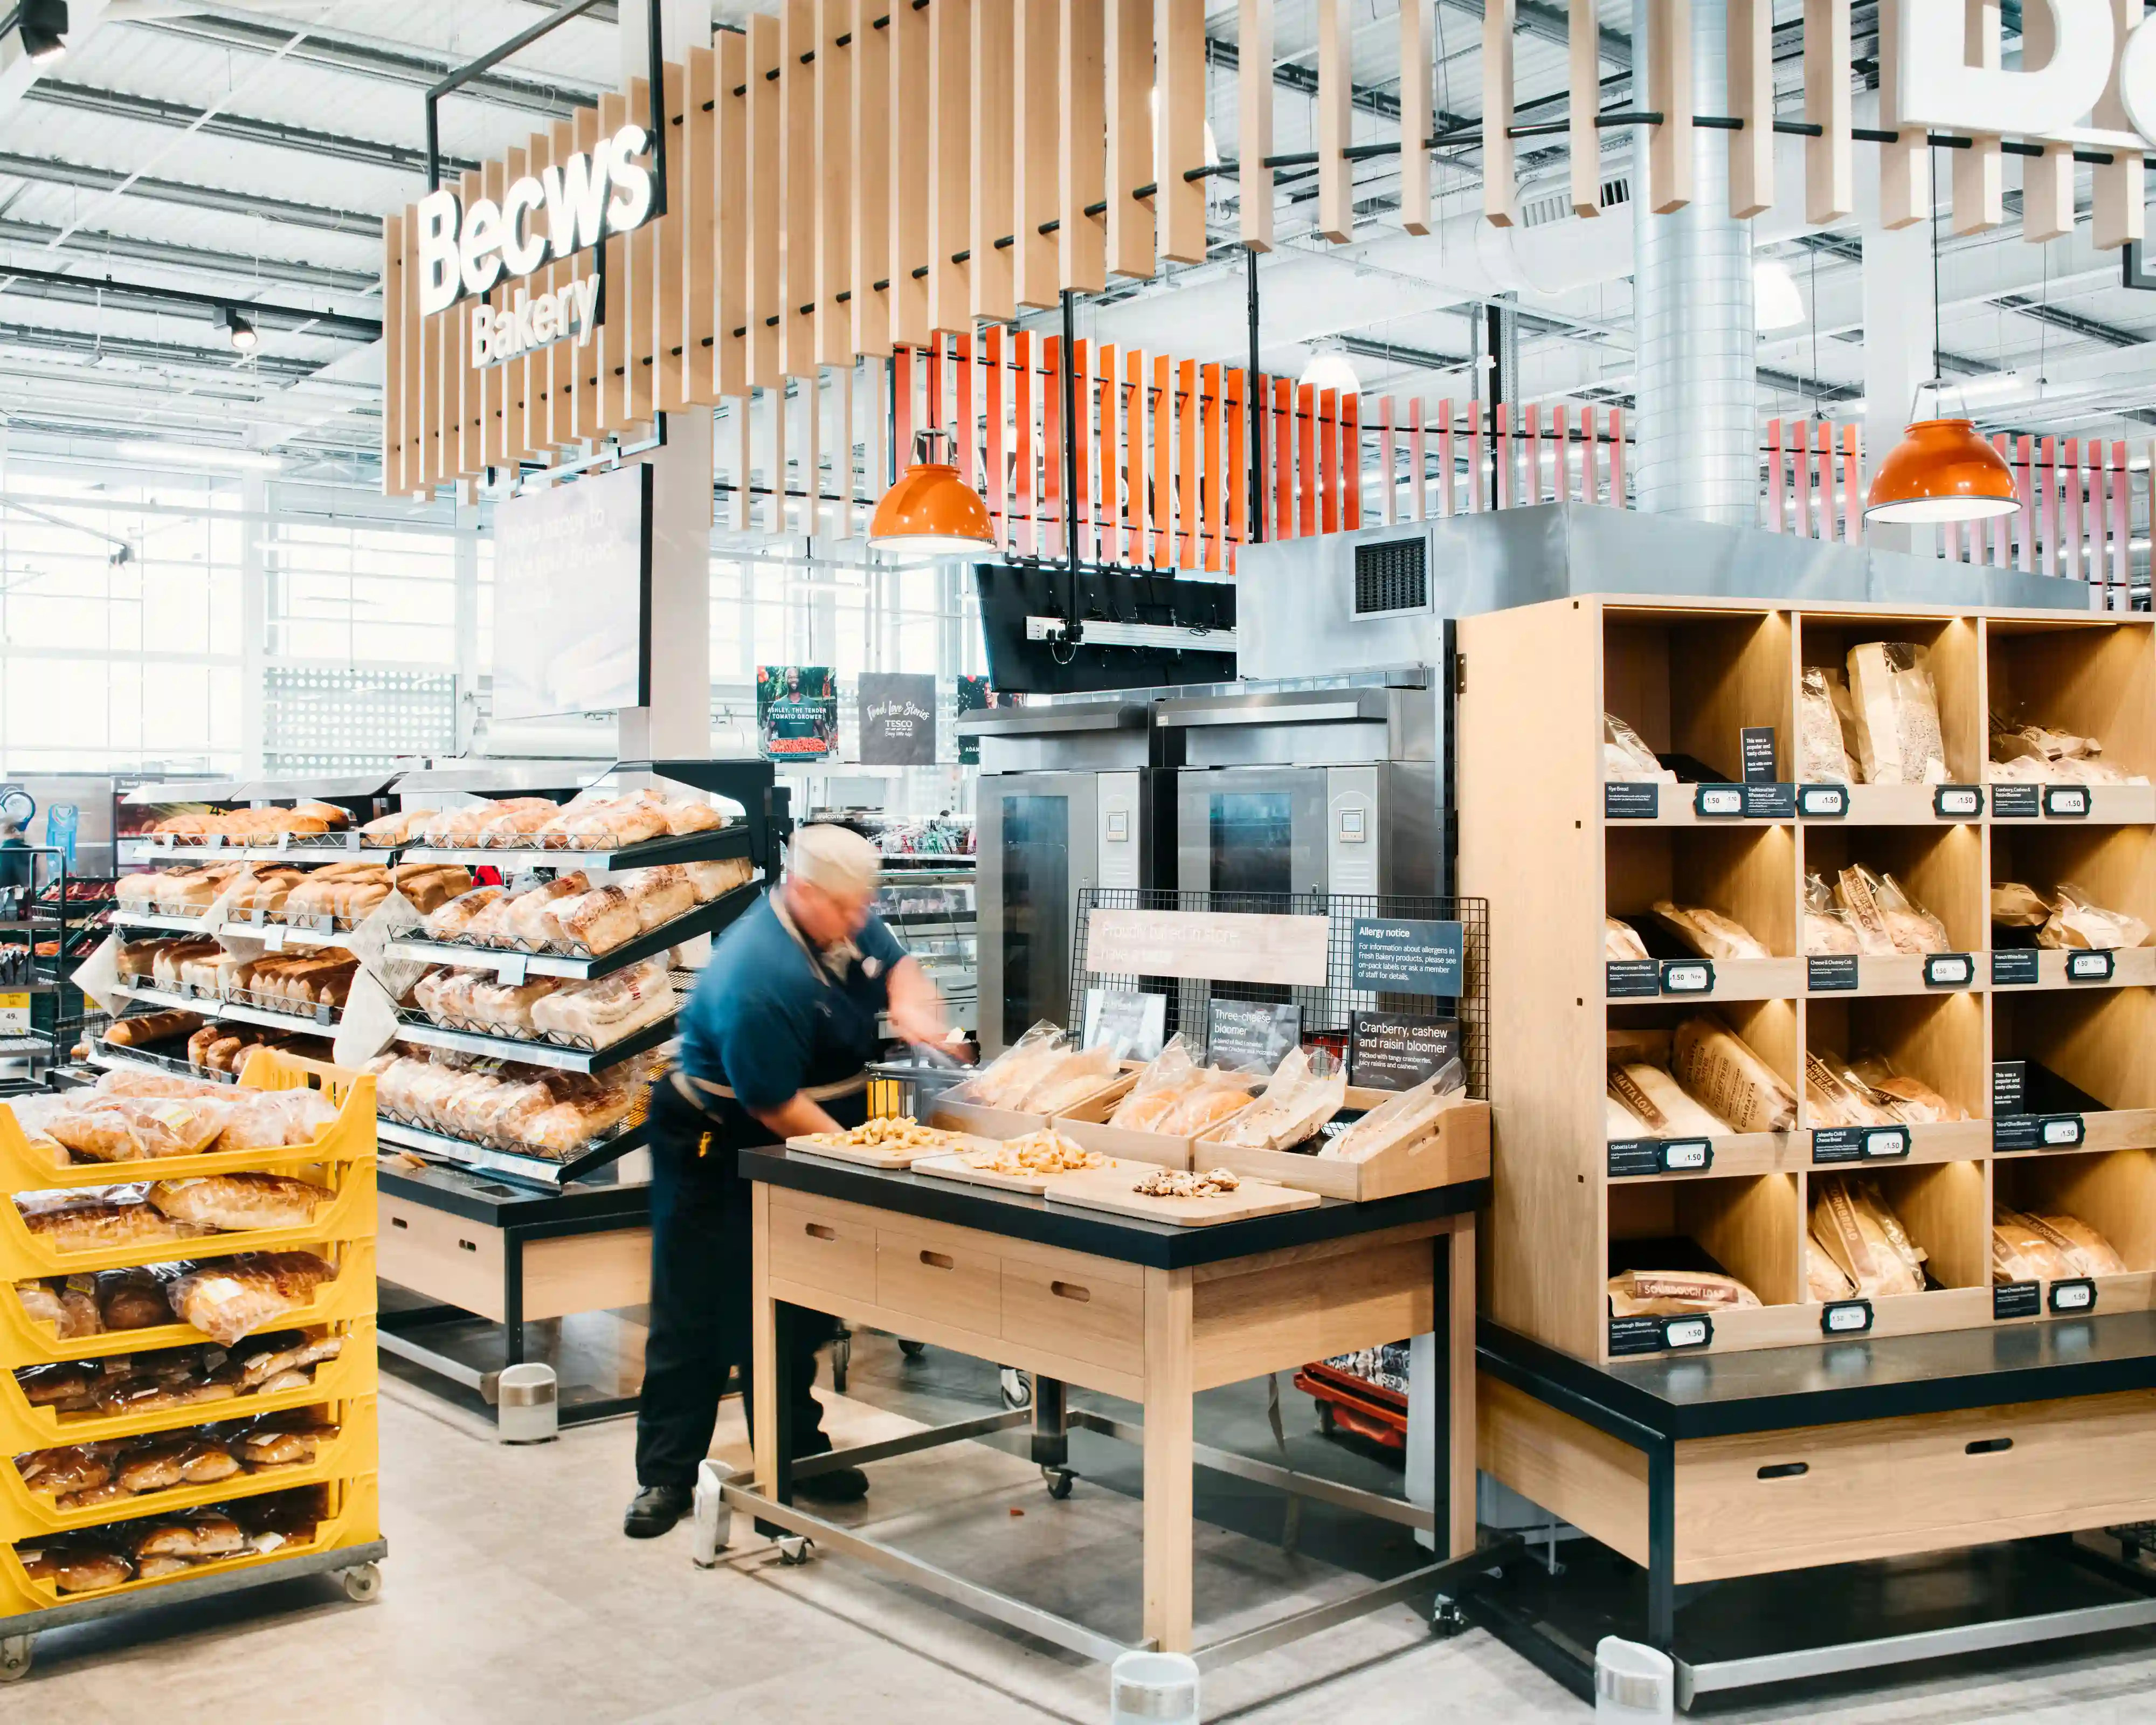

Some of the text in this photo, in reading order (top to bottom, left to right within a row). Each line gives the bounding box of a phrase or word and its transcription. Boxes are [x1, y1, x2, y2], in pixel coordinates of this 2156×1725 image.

[417, 125, 652, 316] Becws
[472, 273, 600, 368] Bakery
[867, 700, 931, 721] Food Love Stories
[884, 720, 913, 728] TESCO
[1359, 927, 1410, 939] Allergy notice
[1370, 943, 1402, 951] information
[1403, 944, 1421, 953] about
[1422, 946, 1448, 955] allergens
[1449, 947, 1455, 955] in
[1376, 953, 1394, 962] Bakery
[1395, 954, 1423, 963] products,
[1425, 956, 1445, 964] please
[1389, 972, 1409, 981] details.
[1214, 1009, 1272, 1024] Three-cheese
[1214, 1022, 1249, 1036] bloomer
[1359, 1021, 1448, 1038] Cranberry, cashew
[1359, 1037, 1447, 1054] and raisin bloomer
[1358, 1059, 1370, 1067] juicy
[1402, 1056, 1432, 1064] cranberries,
[1811, 1064, 1831, 1082] CHILLI
[1634, 1095, 1656, 1118] LOAF
[1740, 1082, 1756, 1128] CIABATTA
[1644, 1284, 1701, 1297] SOURDOUGH
